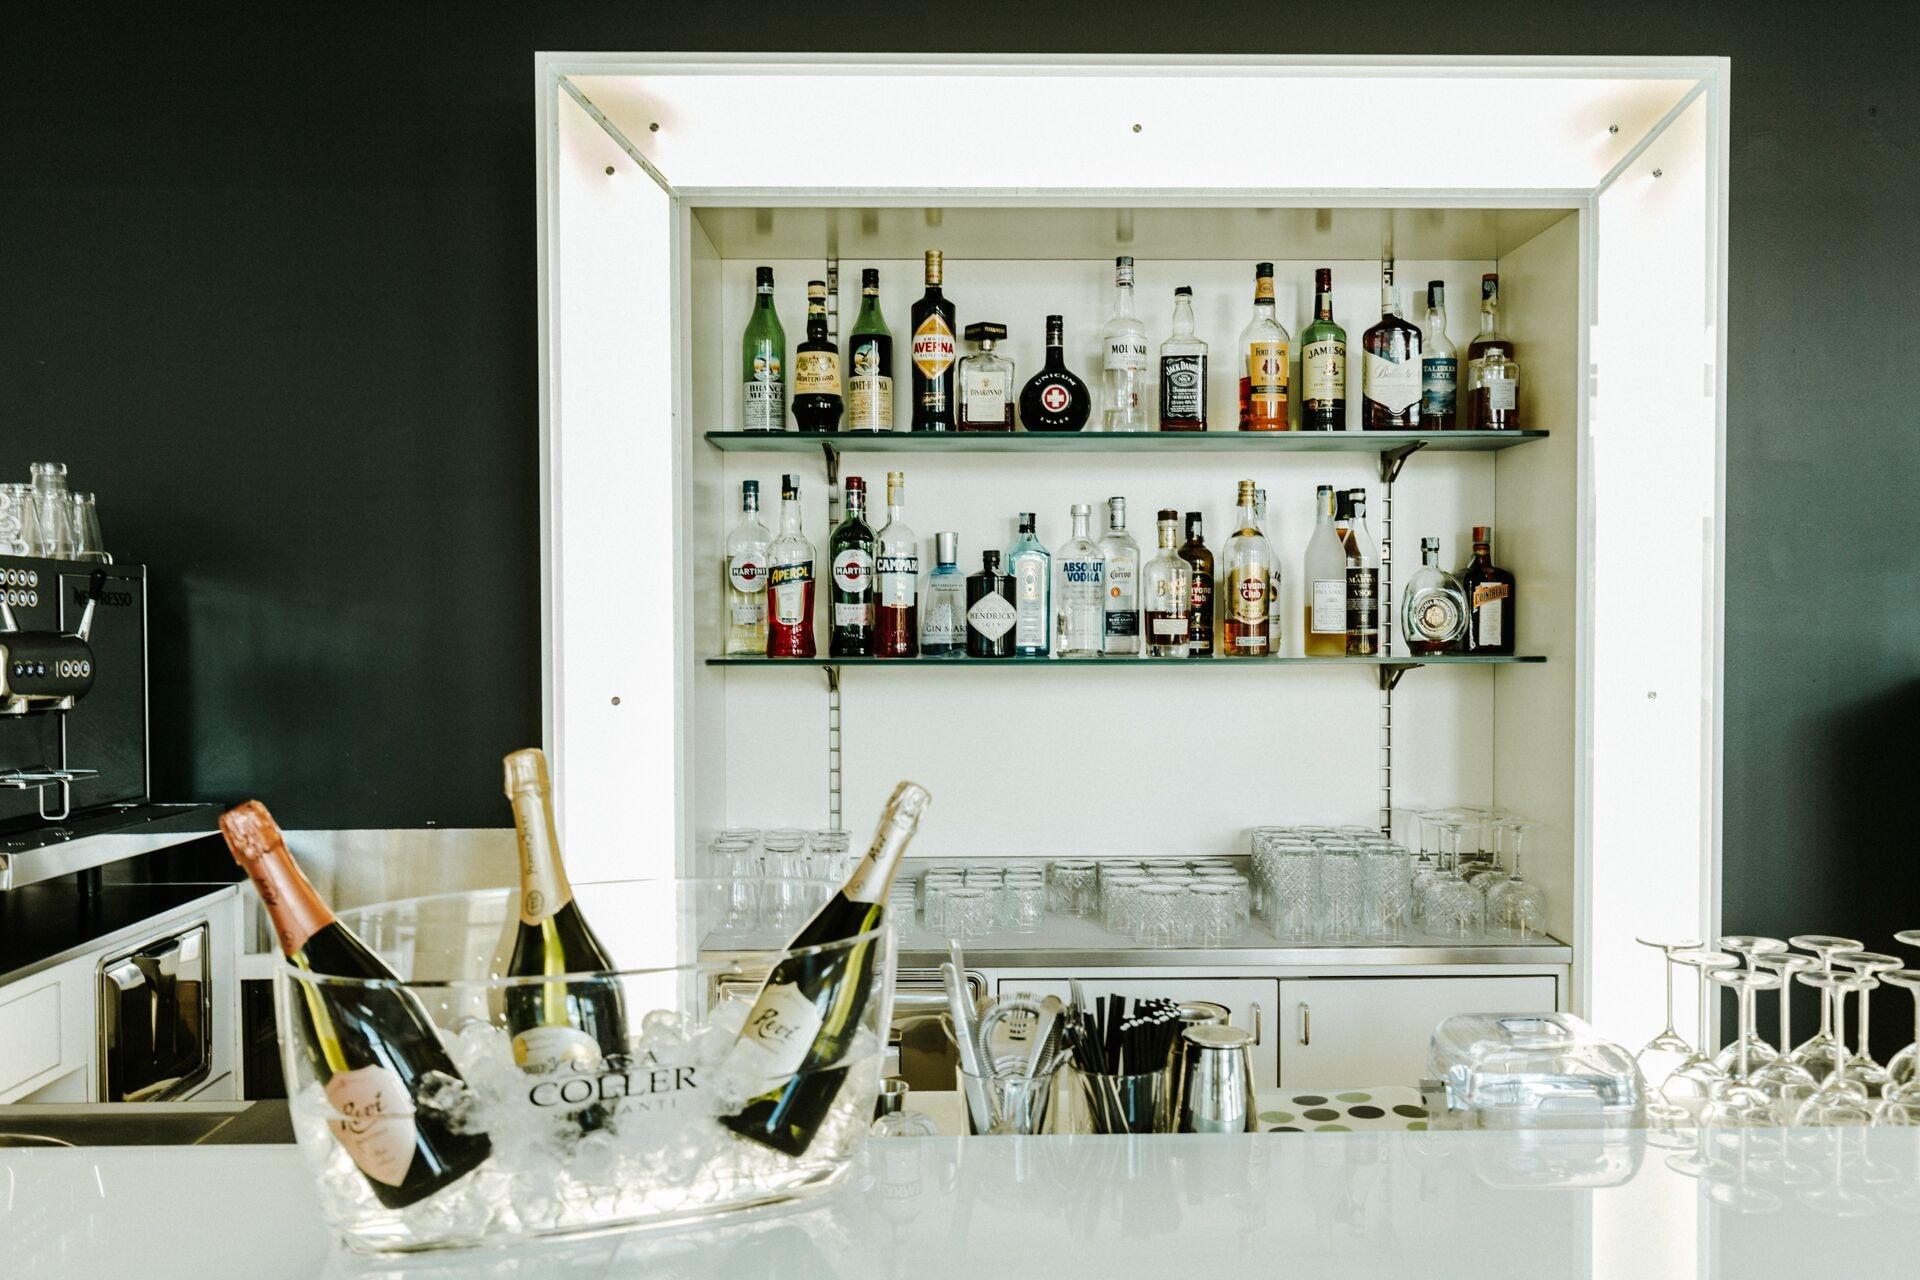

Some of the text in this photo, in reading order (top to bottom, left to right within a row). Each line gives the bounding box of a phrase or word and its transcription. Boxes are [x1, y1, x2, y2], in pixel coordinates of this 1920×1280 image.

[914, 342, 953, 354] AVERNA
[1111, 344, 1147, 355] MOLNAR
[1166, 363, 1181, 376] JACK
[1034, 372, 1077, 387] UNICUM
[836, 567, 870, 575] MARTINI
[877, 558, 918, 572] CAMPAR
[1063, 562, 1103, 572] ABSOLUT
[733, 567, 767, 576] MARTINI
[771, 566, 809, 584] APEROL
[1067, 572, 1100, 582] VODKA
[73, 586, 132, 607] NERESSO
[1242, 590, 1260, 598] Club
[1474, 586, 1509, 605] COINTREAU
[529, 1066, 697, 1106] COLLER
